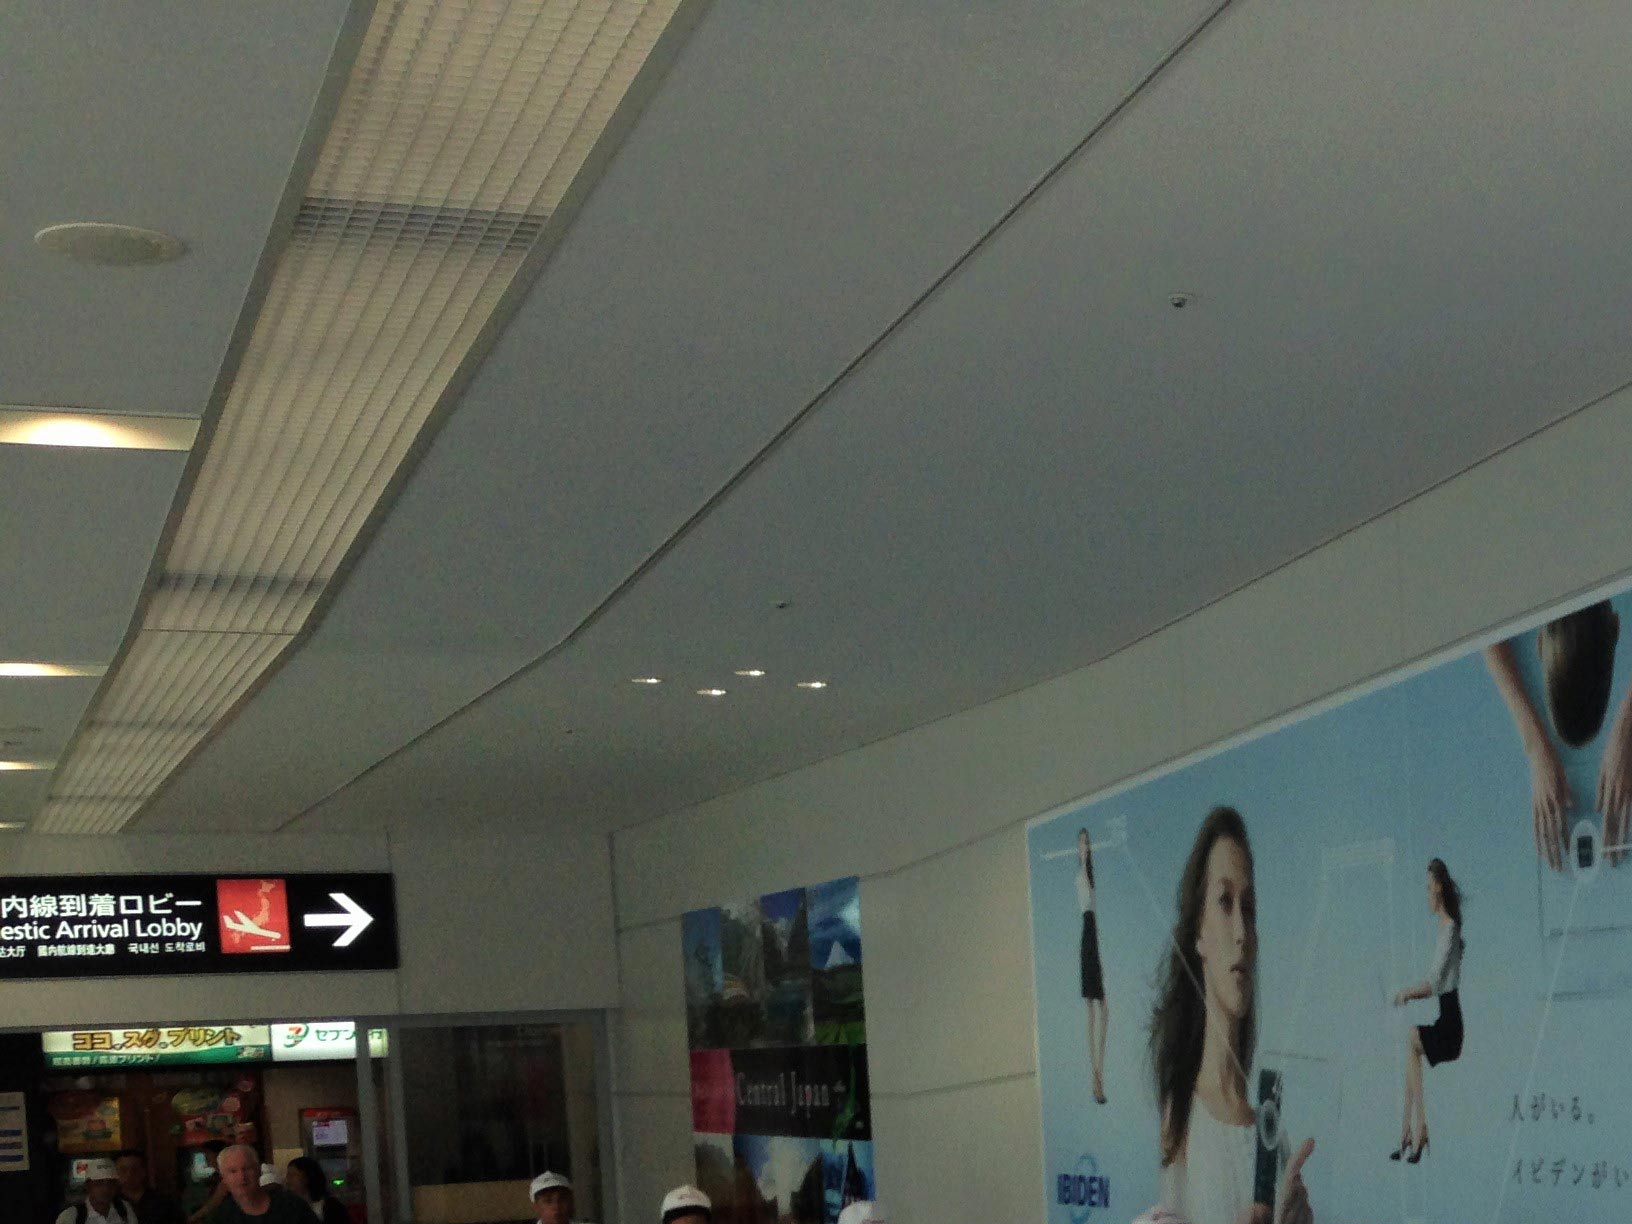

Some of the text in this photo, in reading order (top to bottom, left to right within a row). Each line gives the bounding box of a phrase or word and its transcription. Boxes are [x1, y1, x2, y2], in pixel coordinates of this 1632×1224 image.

[1, 892, 202, 919] 内線到着ロビー
[1, 917, 203, 941] estic Arrival Lobby
[1057, 1173, 1111, 1209] IBIDEN
